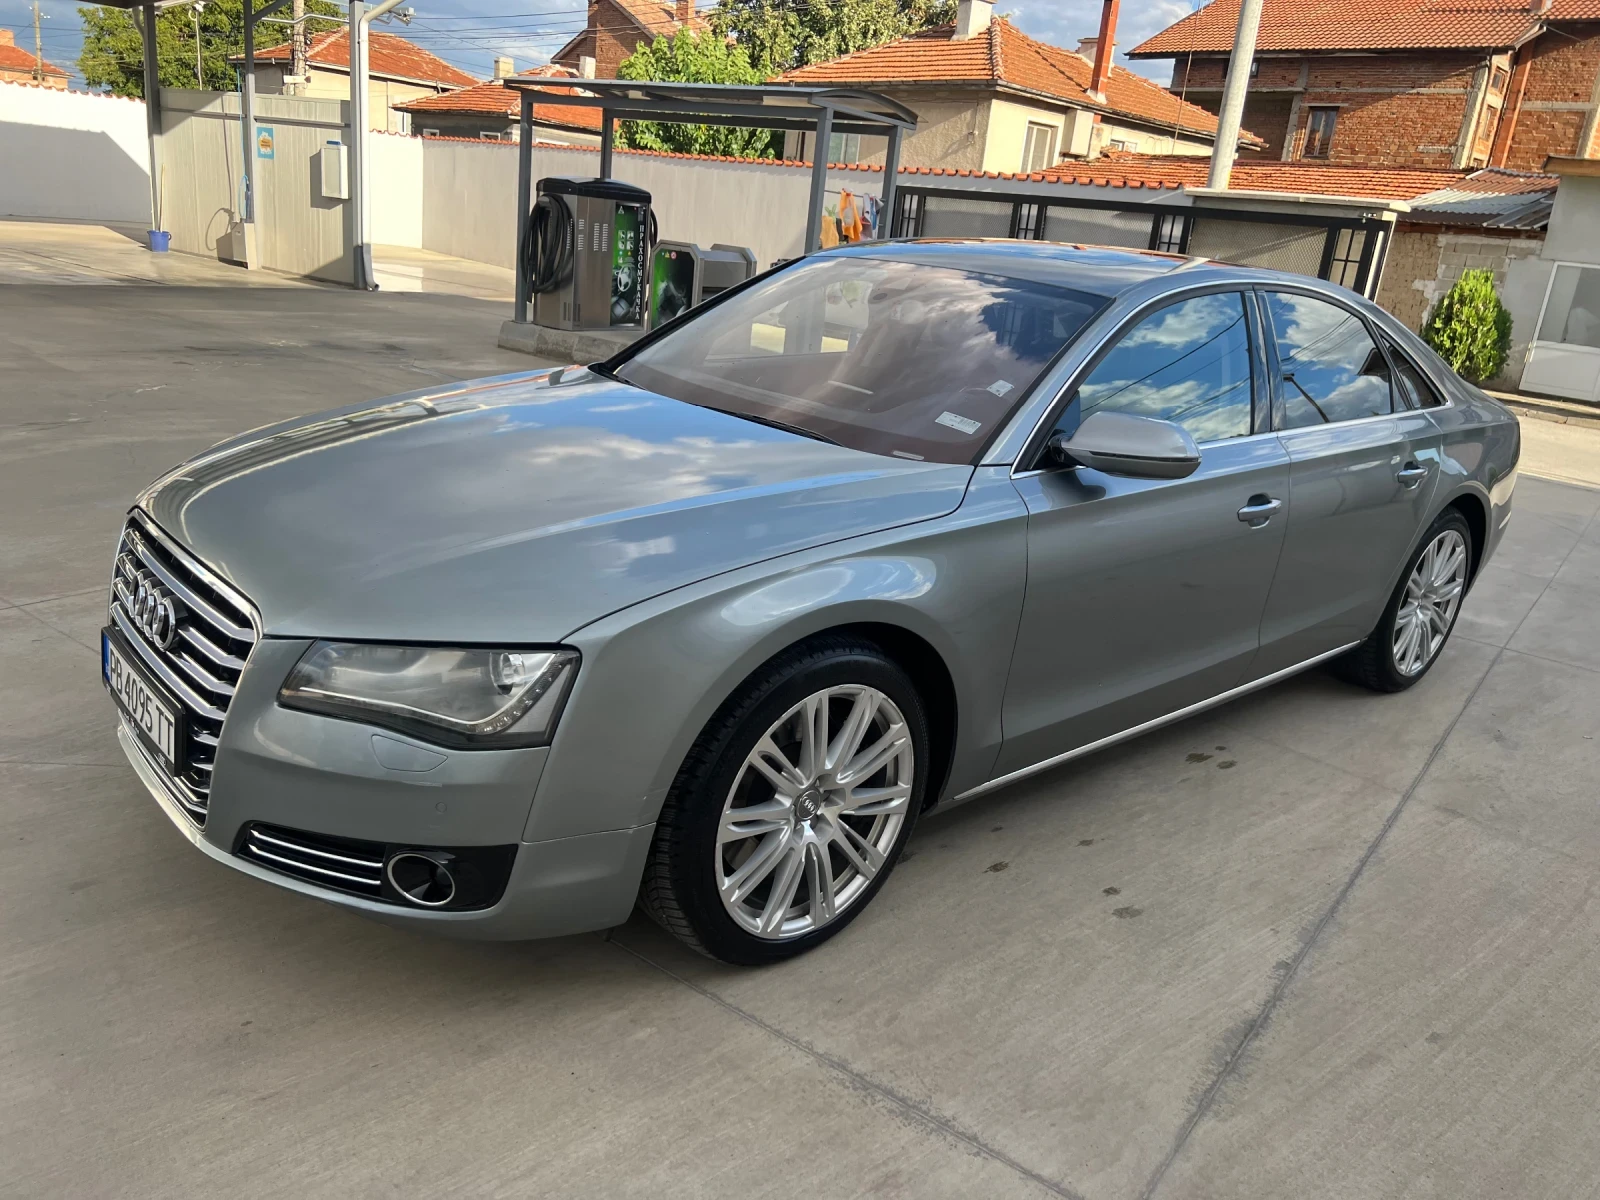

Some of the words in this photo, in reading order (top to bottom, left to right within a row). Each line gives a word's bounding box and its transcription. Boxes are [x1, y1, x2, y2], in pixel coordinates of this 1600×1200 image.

[635, 224, 645, 320] ПРАХОСМУКАЧКА
[110, 649, 123, 695] PB
[124, 671, 153, 733] 4095
[156, 705, 173, 756] TT
